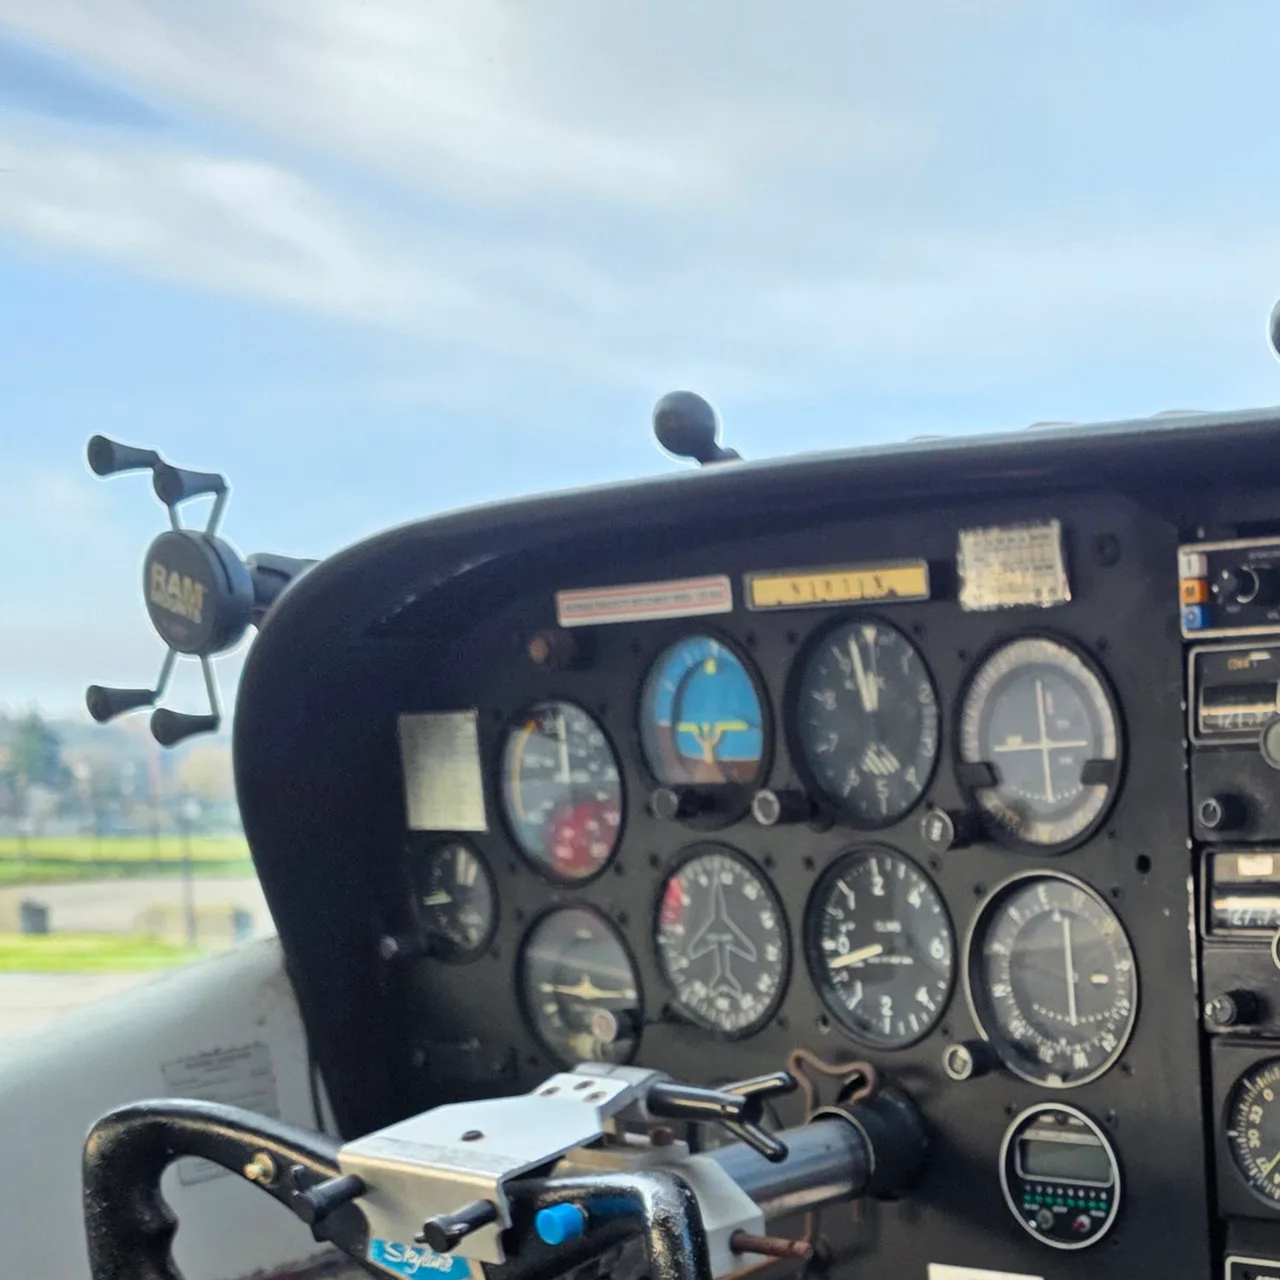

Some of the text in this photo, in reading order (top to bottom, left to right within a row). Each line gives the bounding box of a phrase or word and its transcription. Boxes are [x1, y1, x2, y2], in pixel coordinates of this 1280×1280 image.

[151, 562, 204, 612] RAM
[872, 875, 885, 897] 2
[930, 937, 945, 960] 6
